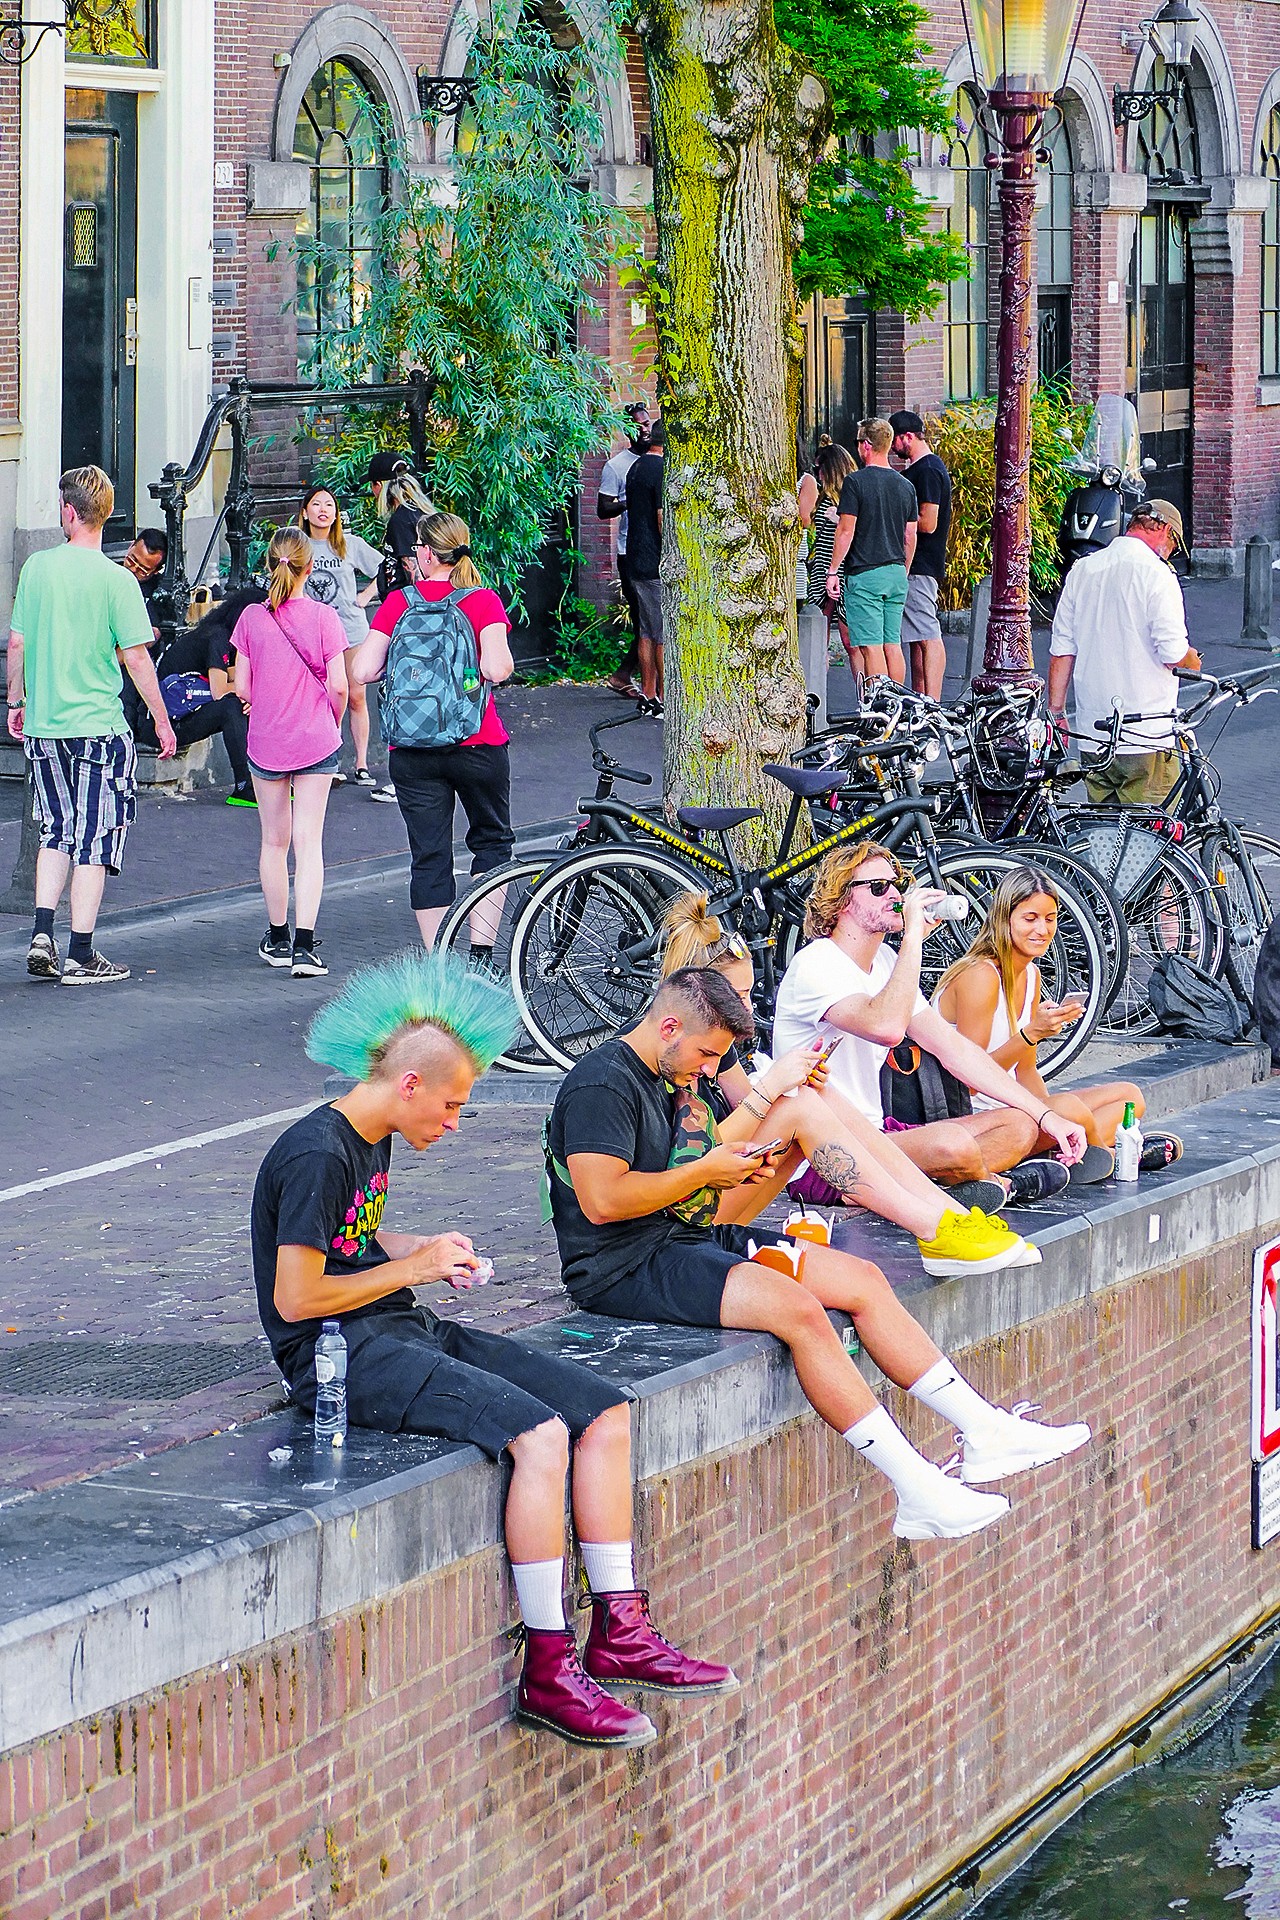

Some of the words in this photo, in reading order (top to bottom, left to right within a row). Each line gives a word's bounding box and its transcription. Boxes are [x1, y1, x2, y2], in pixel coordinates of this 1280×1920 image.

[630, 813, 653, 831] THE
[652, 827, 702, 858] STUDENT
[767, 863, 790, 880] THE
[789, 834, 838, 867] STUDENT
[839, 814, 877, 839] HOTEL
